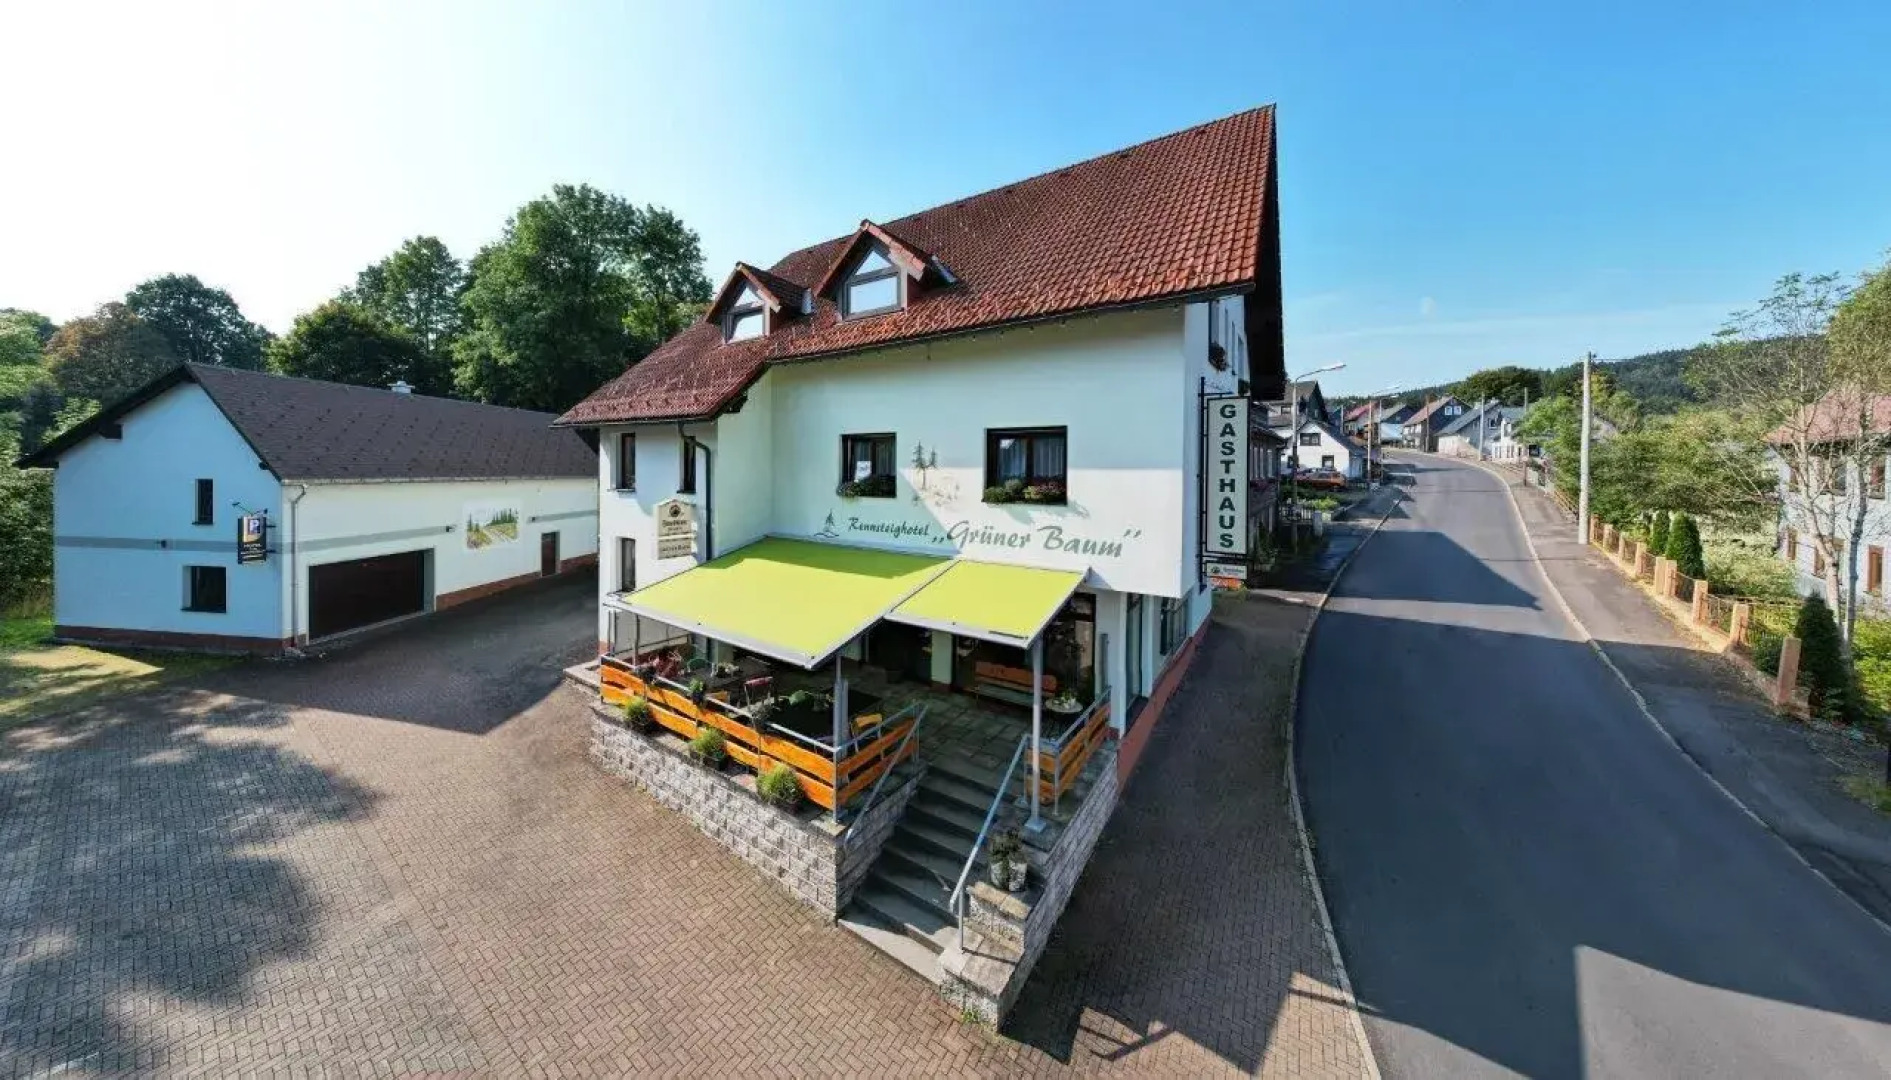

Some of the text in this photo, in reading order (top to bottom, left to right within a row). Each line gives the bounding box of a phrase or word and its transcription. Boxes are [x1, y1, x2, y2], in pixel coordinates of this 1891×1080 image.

[1219, 404, 1236, 549] GASTHAUS
[249, 519, 260, 533] P
[848, 517, 929, 538] Rennsteighotel
